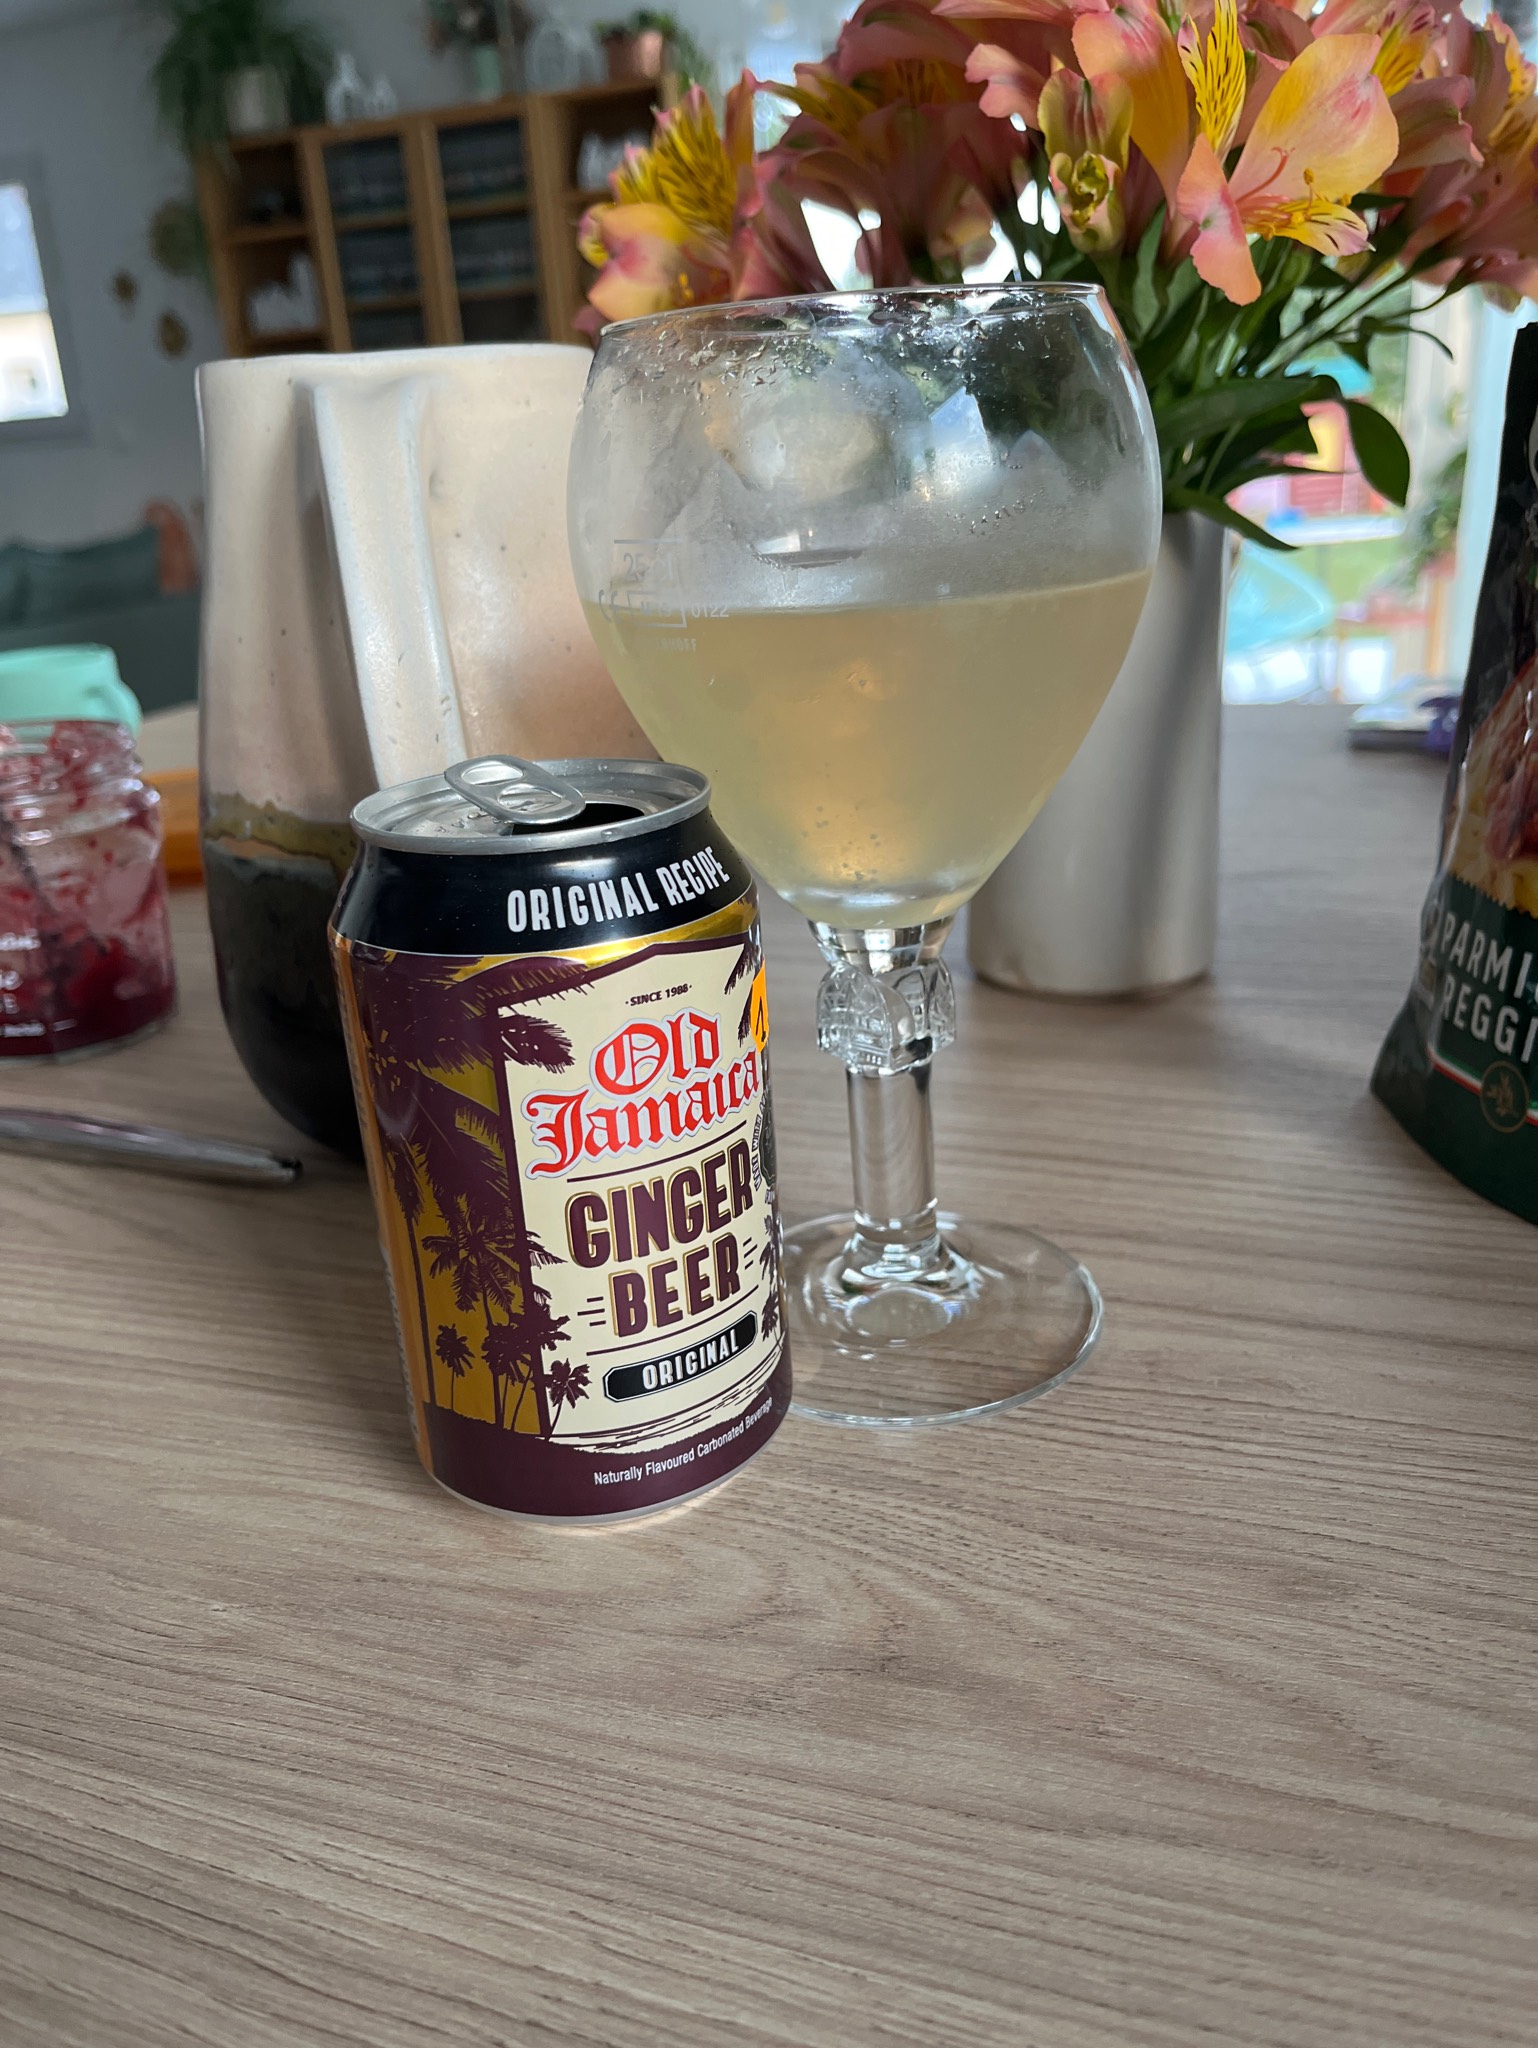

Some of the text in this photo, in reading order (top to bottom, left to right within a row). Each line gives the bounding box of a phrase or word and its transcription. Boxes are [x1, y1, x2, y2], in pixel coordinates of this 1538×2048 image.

[507, 846, 731, 933] ORIGINAL RECIPE
[1441, 911, 1538, 1003] PARMI
[592, 1010, 721, 1097] Old
[1441, 972, 1538, 1064] REGGI
[523, 1048, 761, 1177] Jamaica
[565, 1138, 754, 1269] GINGER
[608, 1231, 740, 1338] BEER
[641, 1329, 740, 1391] ORIGINAL
[593, 1396, 773, 1485] Naturally Flavoured Carbonated Beverage
